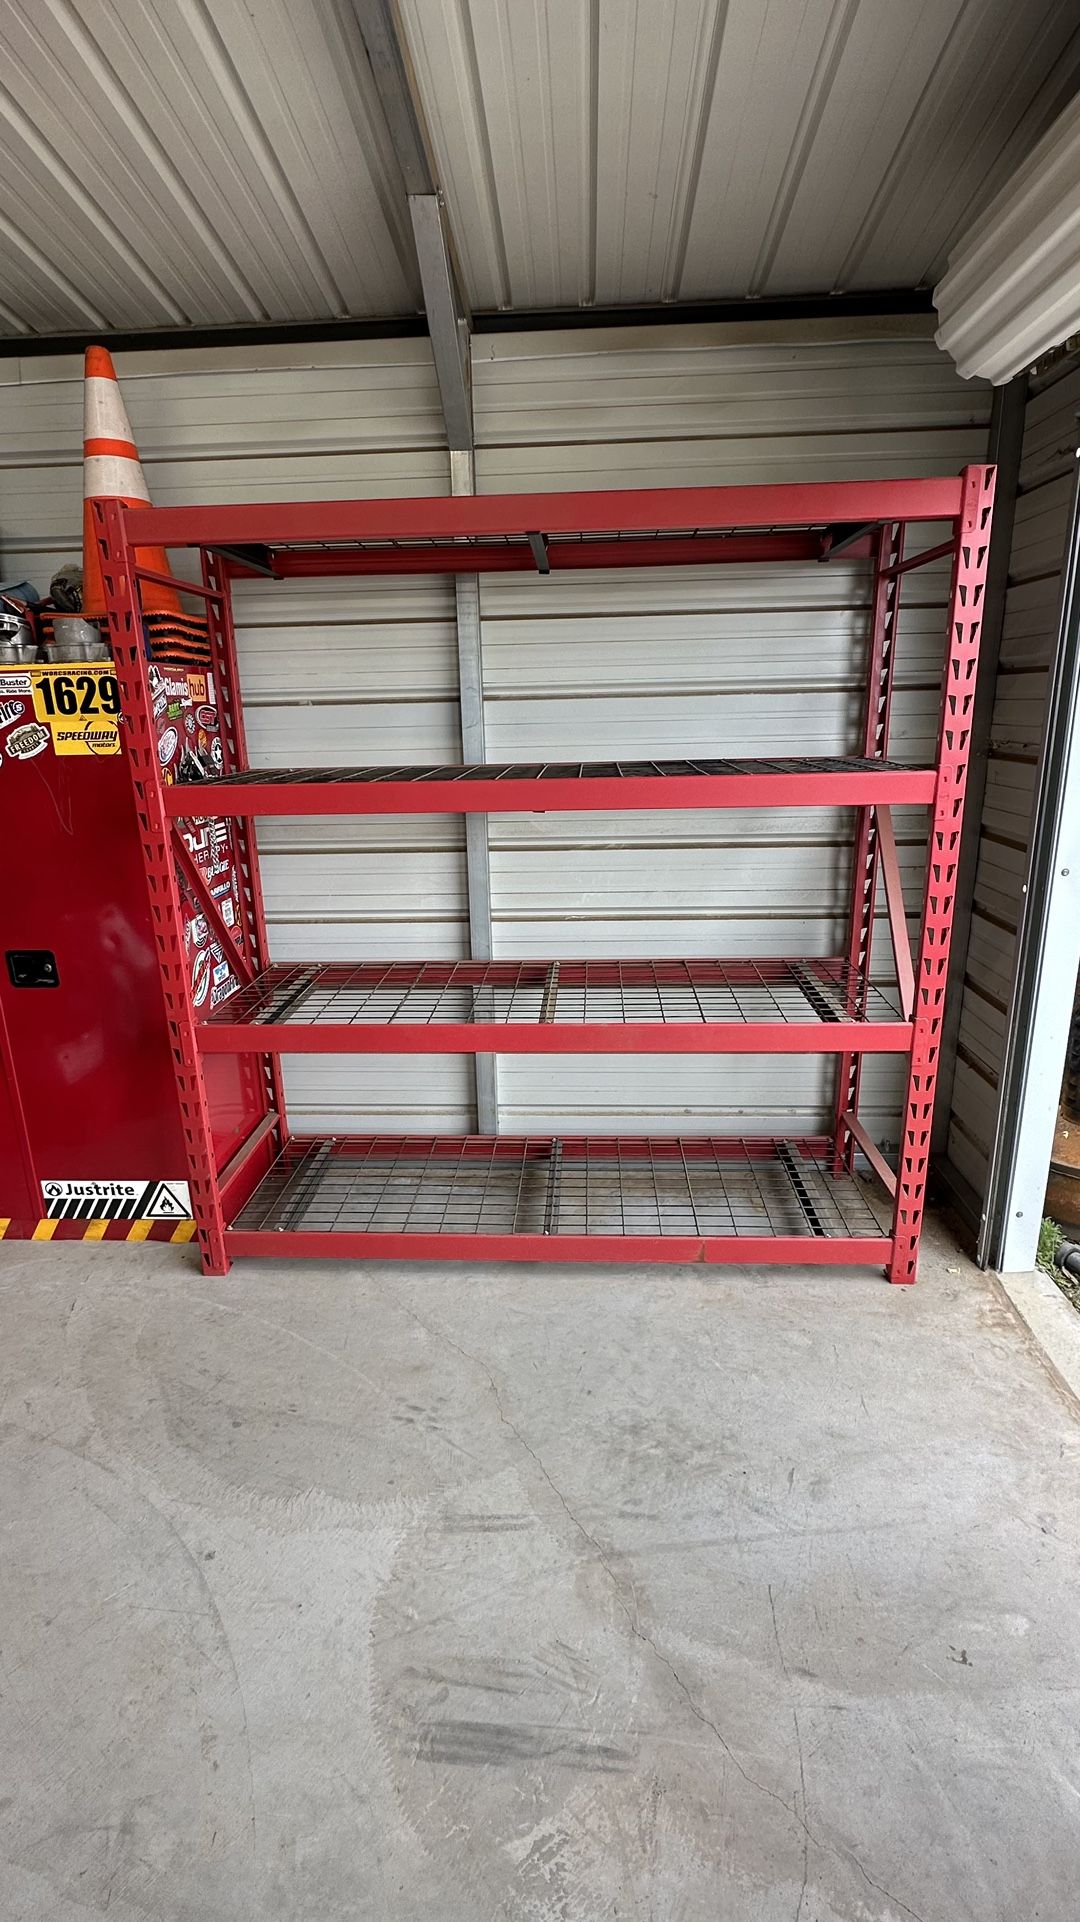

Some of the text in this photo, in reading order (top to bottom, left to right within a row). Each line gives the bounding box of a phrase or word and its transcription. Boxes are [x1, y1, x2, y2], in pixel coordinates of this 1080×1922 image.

[36, 676, 121, 715] 1629
[188, 678, 205, 698] hub
[10, 731, 46, 754] FREEDOM
[57, 731, 118, 741] SPEEDWAY
[66, 1183, 135, 1196] Justrite
